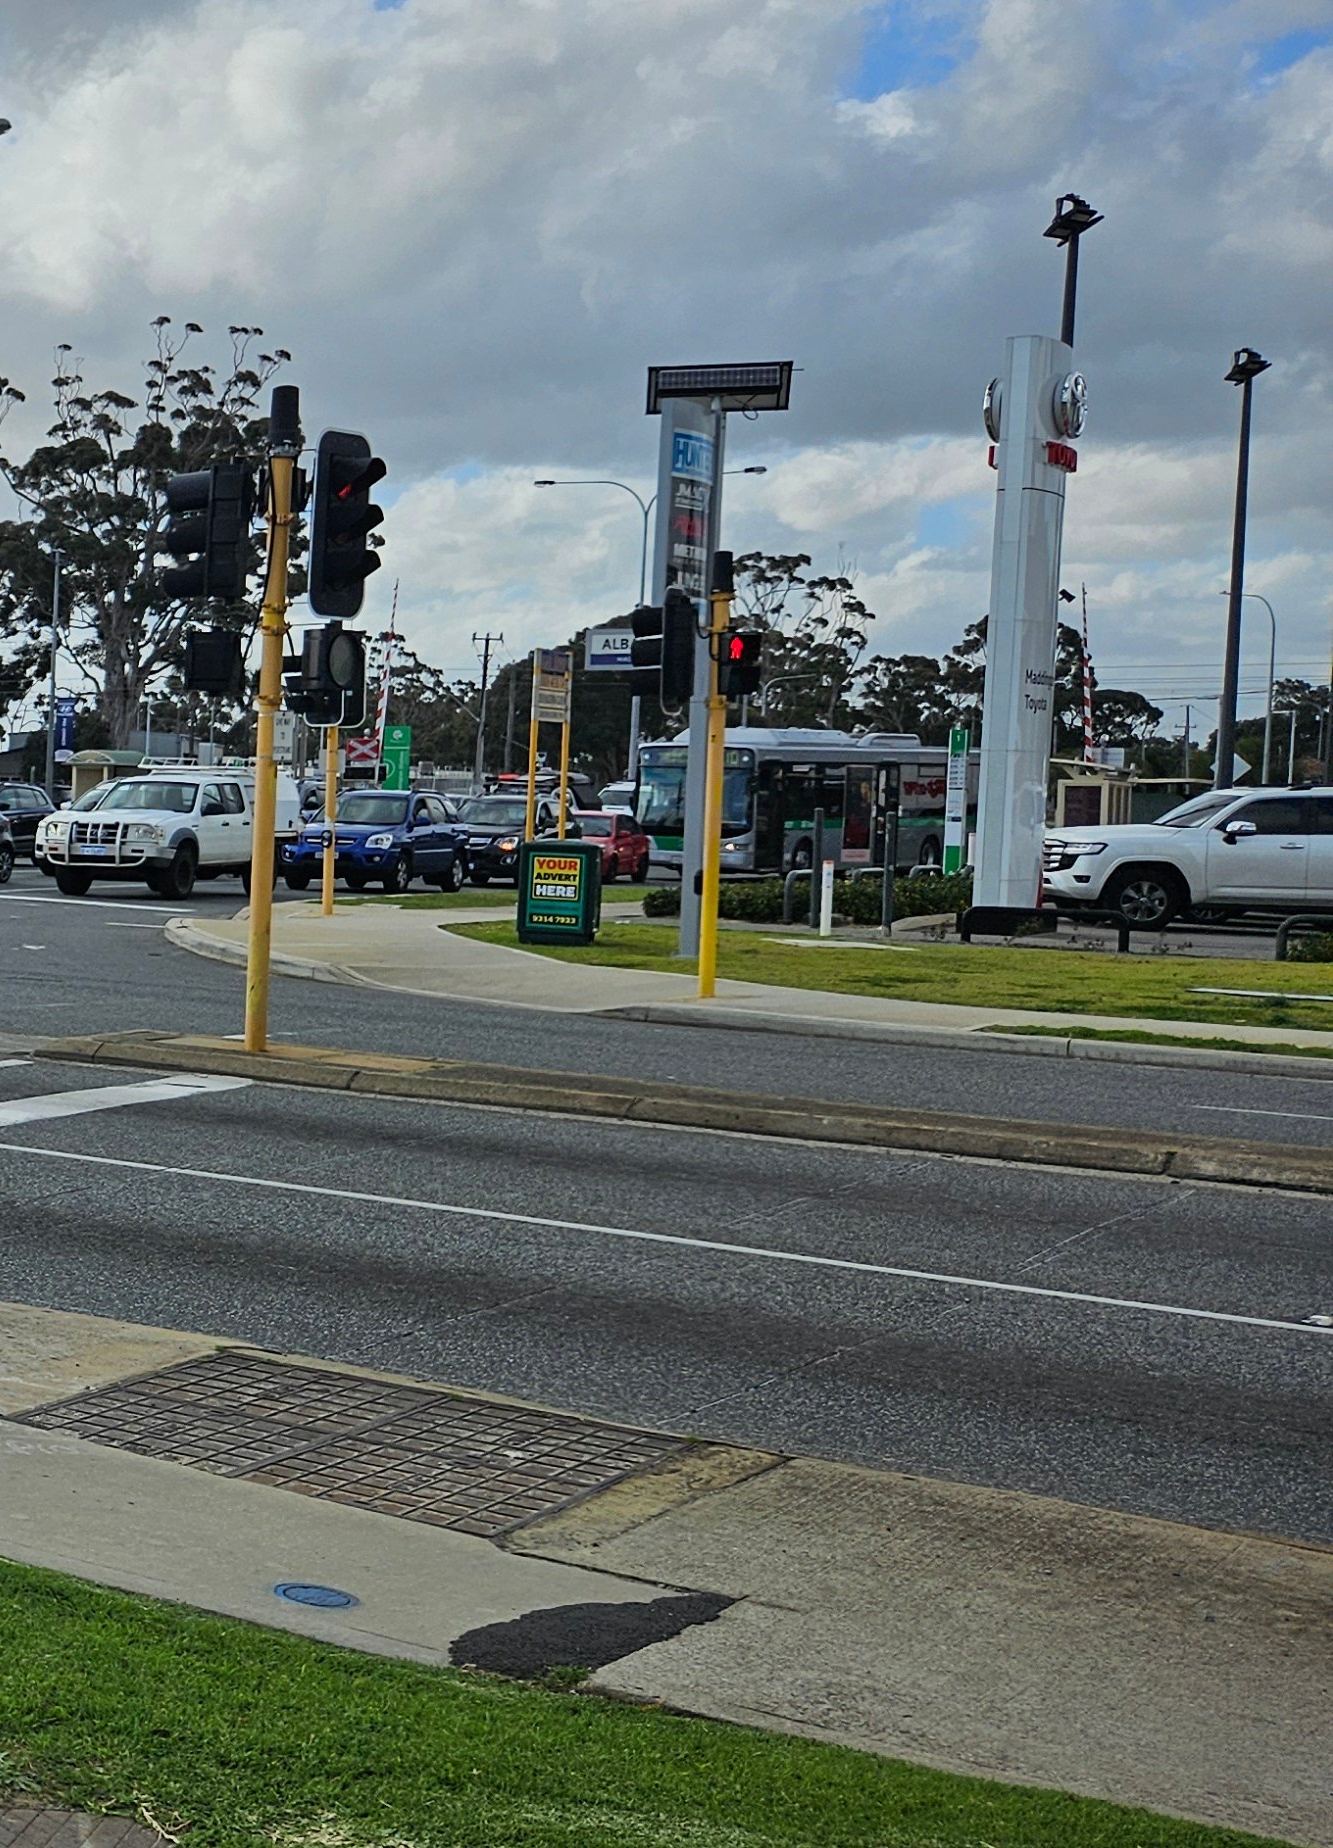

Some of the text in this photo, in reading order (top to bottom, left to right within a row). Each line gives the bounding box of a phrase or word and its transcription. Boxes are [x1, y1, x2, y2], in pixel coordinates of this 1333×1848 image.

[602, 638, 632, 650] ALB
[1025, 694, 1047, 714] Toyota
[536, 859, 578, 871] YOUR
[535, 872, 578, 882] ADVERT
[535, 884, 576, 897] HERE
